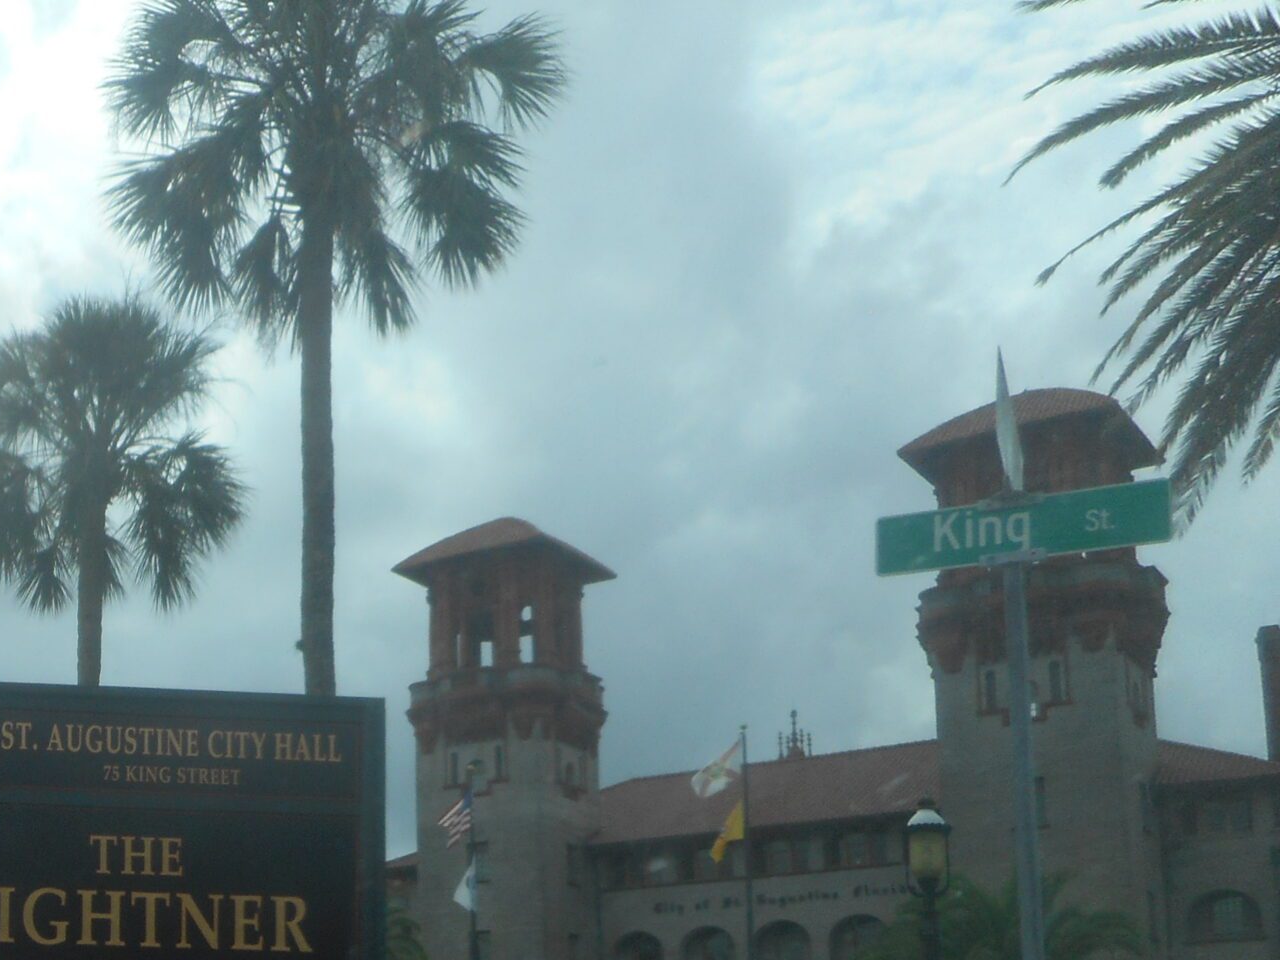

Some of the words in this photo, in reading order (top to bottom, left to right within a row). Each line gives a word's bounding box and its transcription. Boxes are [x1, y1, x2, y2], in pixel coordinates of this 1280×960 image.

[932, 510, 1032, 552] King
[1084, 507, 1117, 533] St.
[0, 720, 38, 751] ST.
[46, 723, 200, 758] AUGUSTINE
[207, 728, 268, 761] CITY
[274, 731, 342, 763] HALL
[103, 763, 121, 783] 75
[125, 764, 172, 785] KING
[176, 766, 241, 786] STREET
[89, 834, 183, 877] THE
